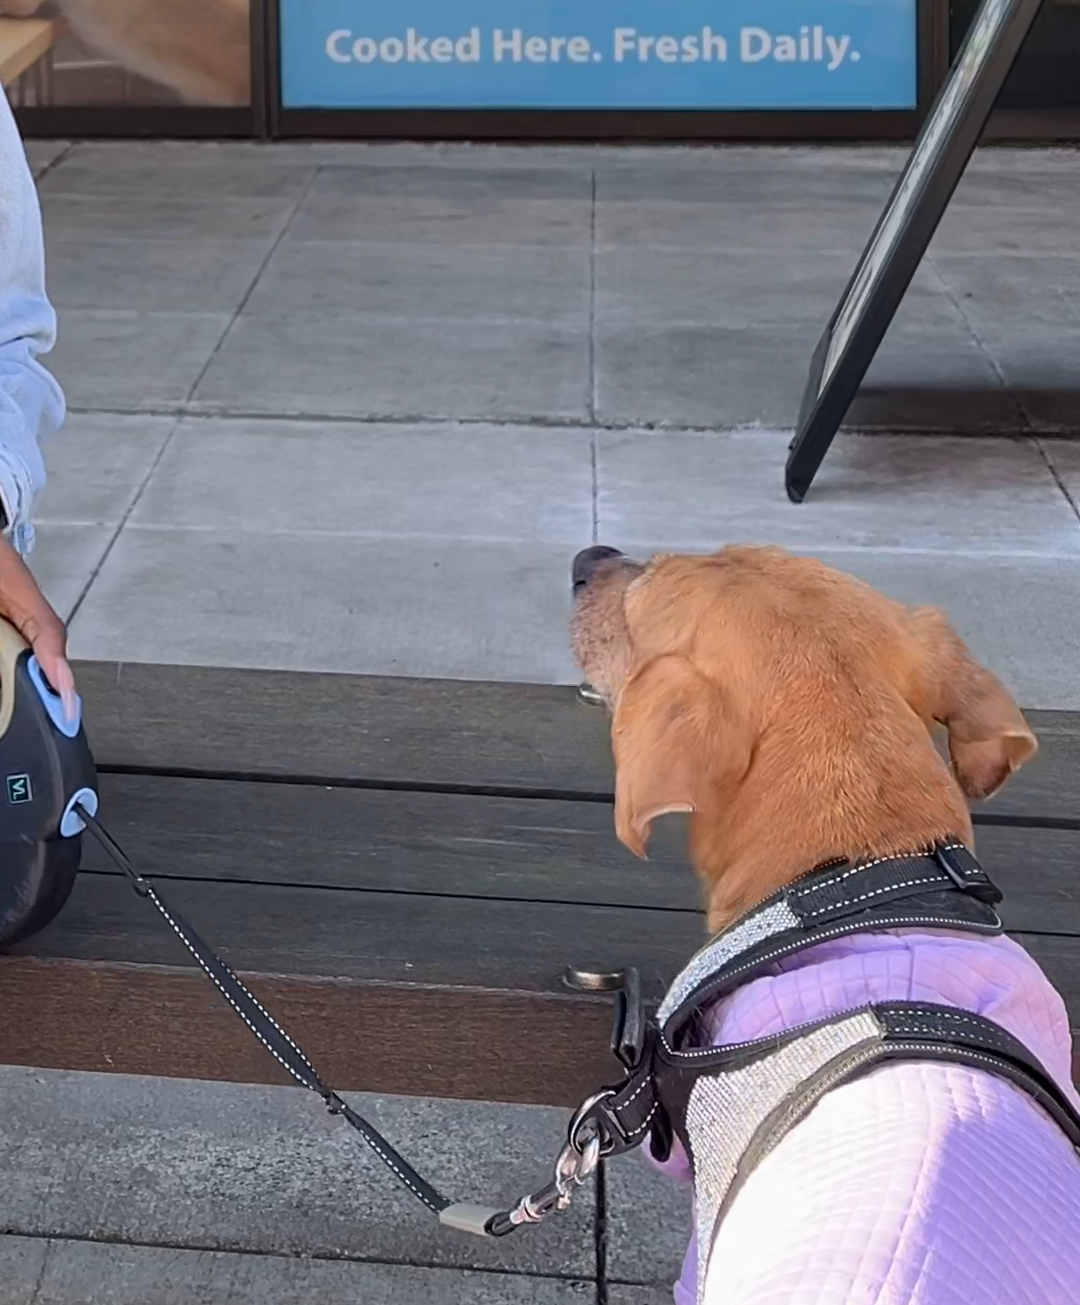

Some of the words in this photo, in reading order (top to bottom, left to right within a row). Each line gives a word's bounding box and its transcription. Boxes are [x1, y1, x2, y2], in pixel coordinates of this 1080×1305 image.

[325, 27, 481, 65] Cooked
[493, 28, 602, 64] Here.
[614, 26, 727, 63] Fresh
[739, 25, 861, 71] Daily.
